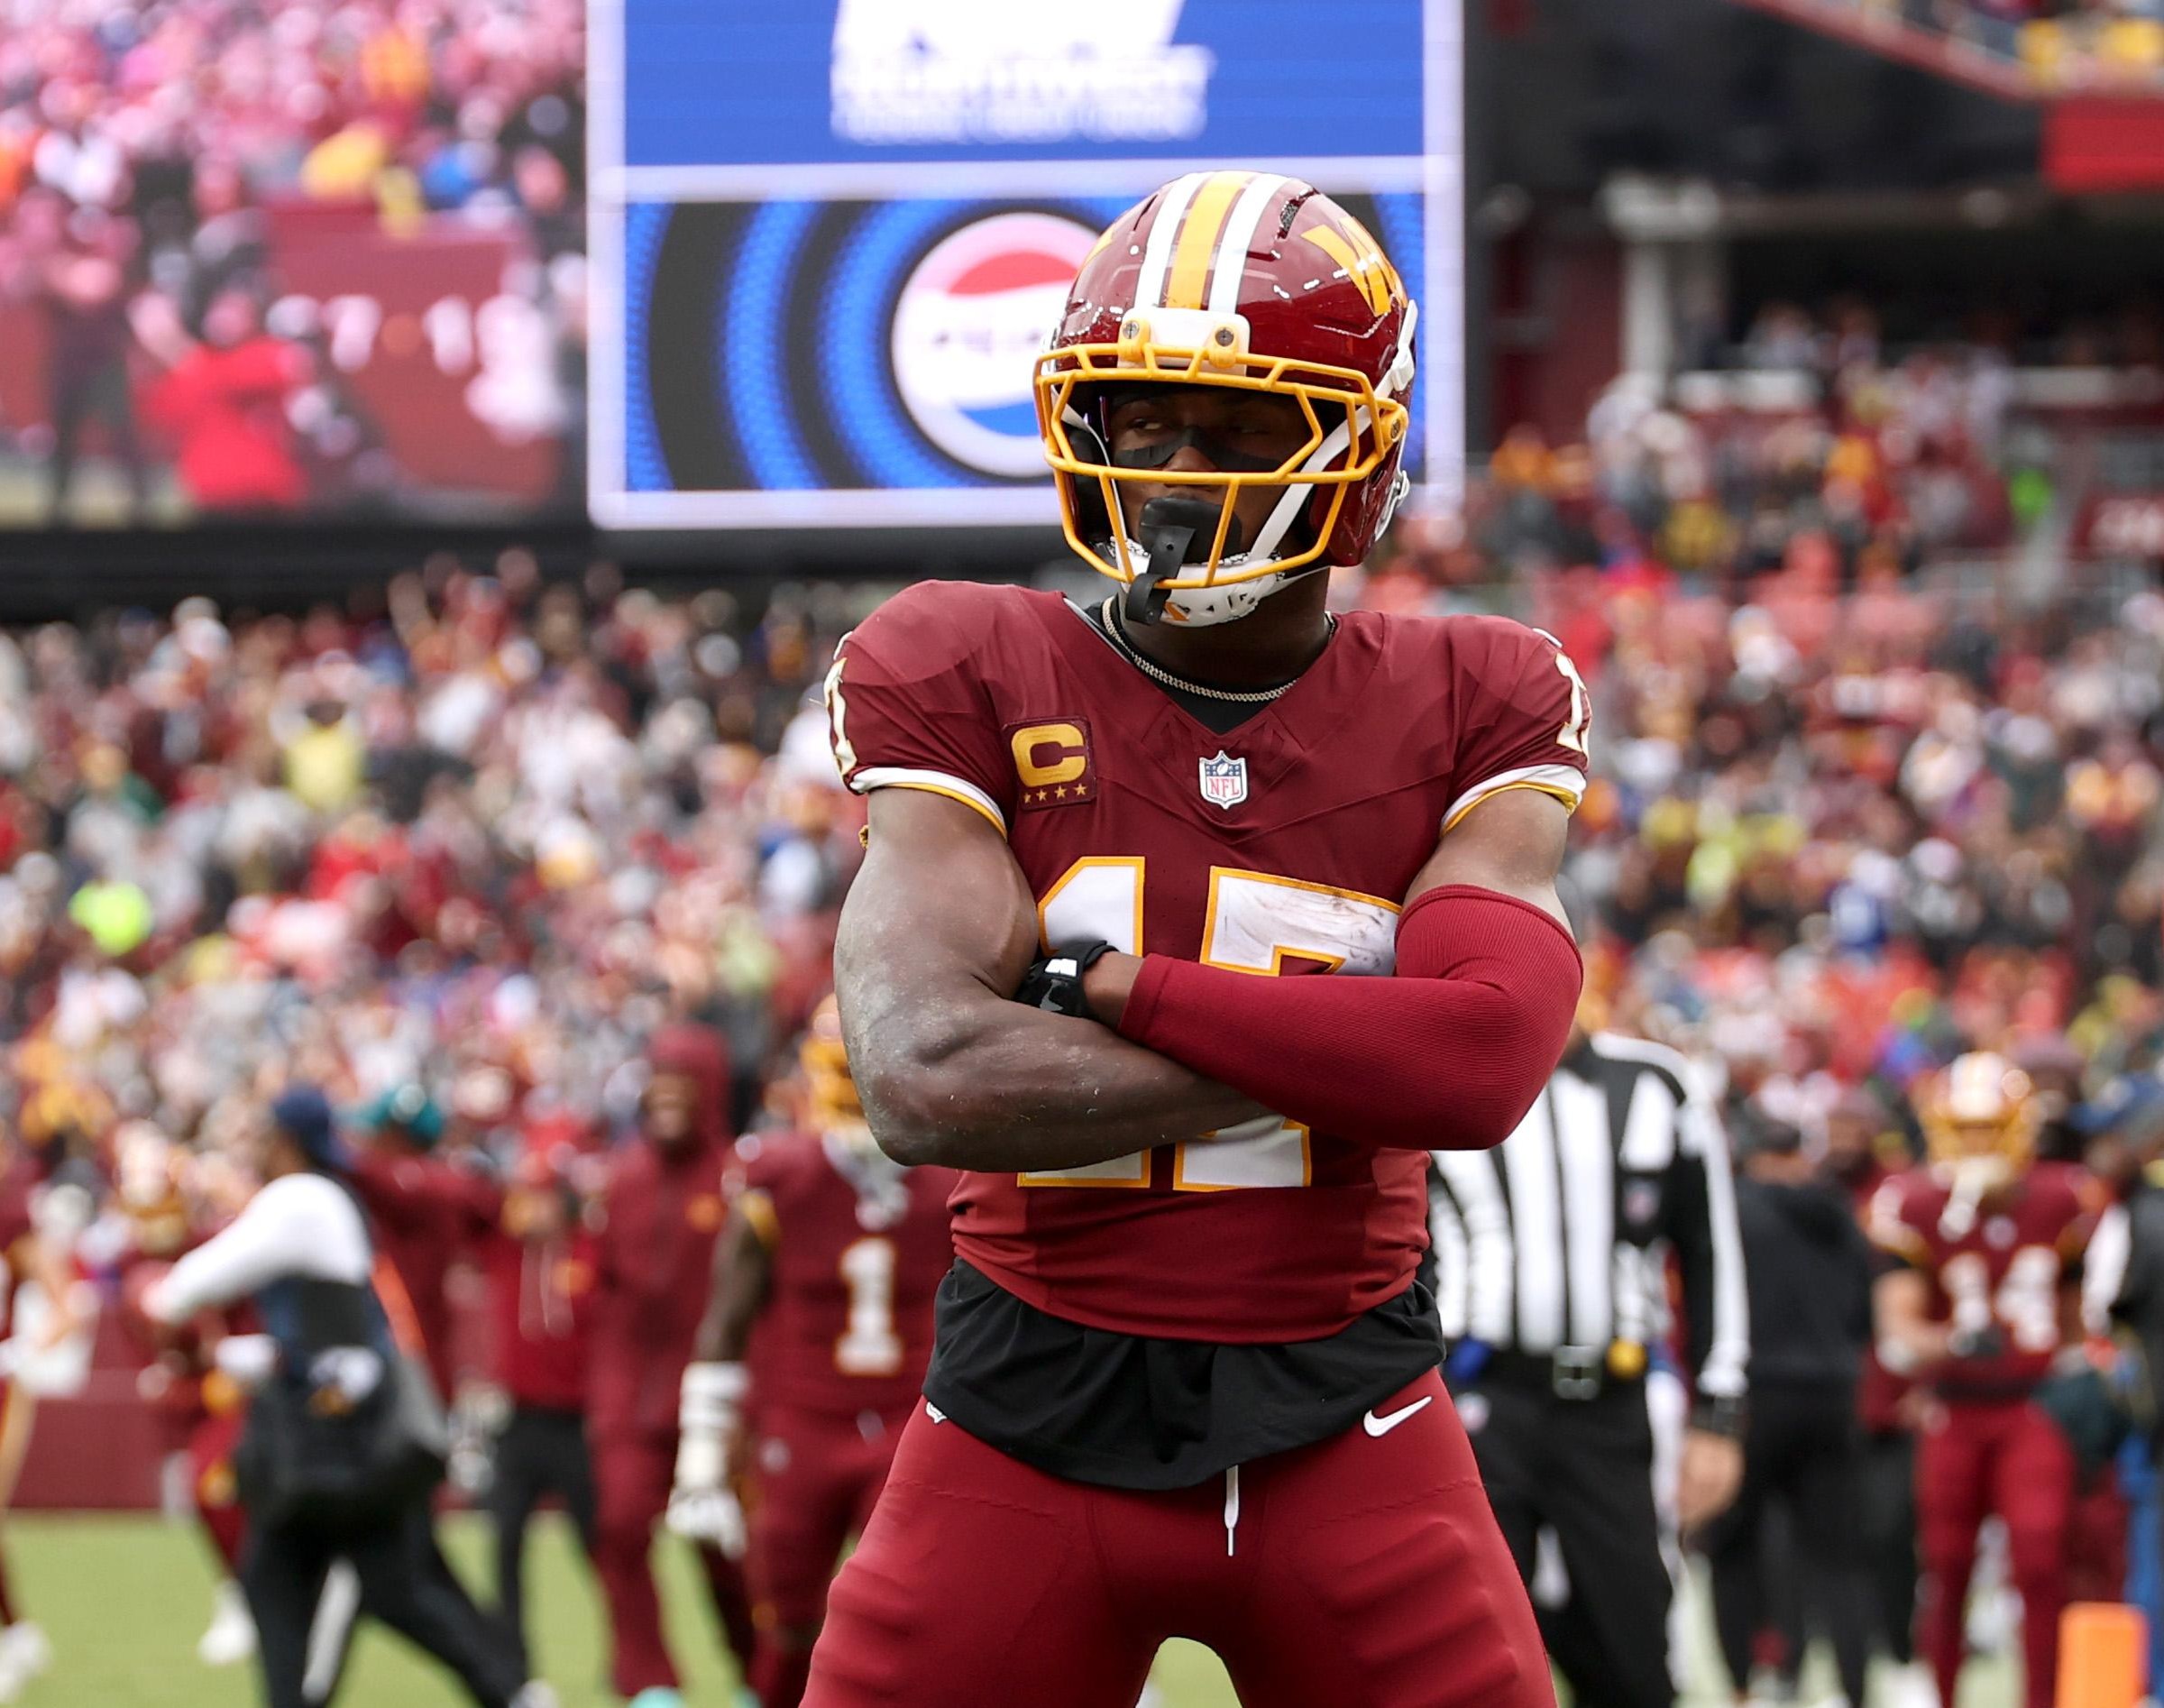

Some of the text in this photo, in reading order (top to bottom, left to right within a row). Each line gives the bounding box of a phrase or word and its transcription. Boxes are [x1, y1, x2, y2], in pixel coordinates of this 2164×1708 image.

[1011, 723, 1087, 787] C
[1209, 778, 1240, 798] NFL
[835, 1235, 903, 1376] 1
[1939, 1247, 2060, 1351] 14
